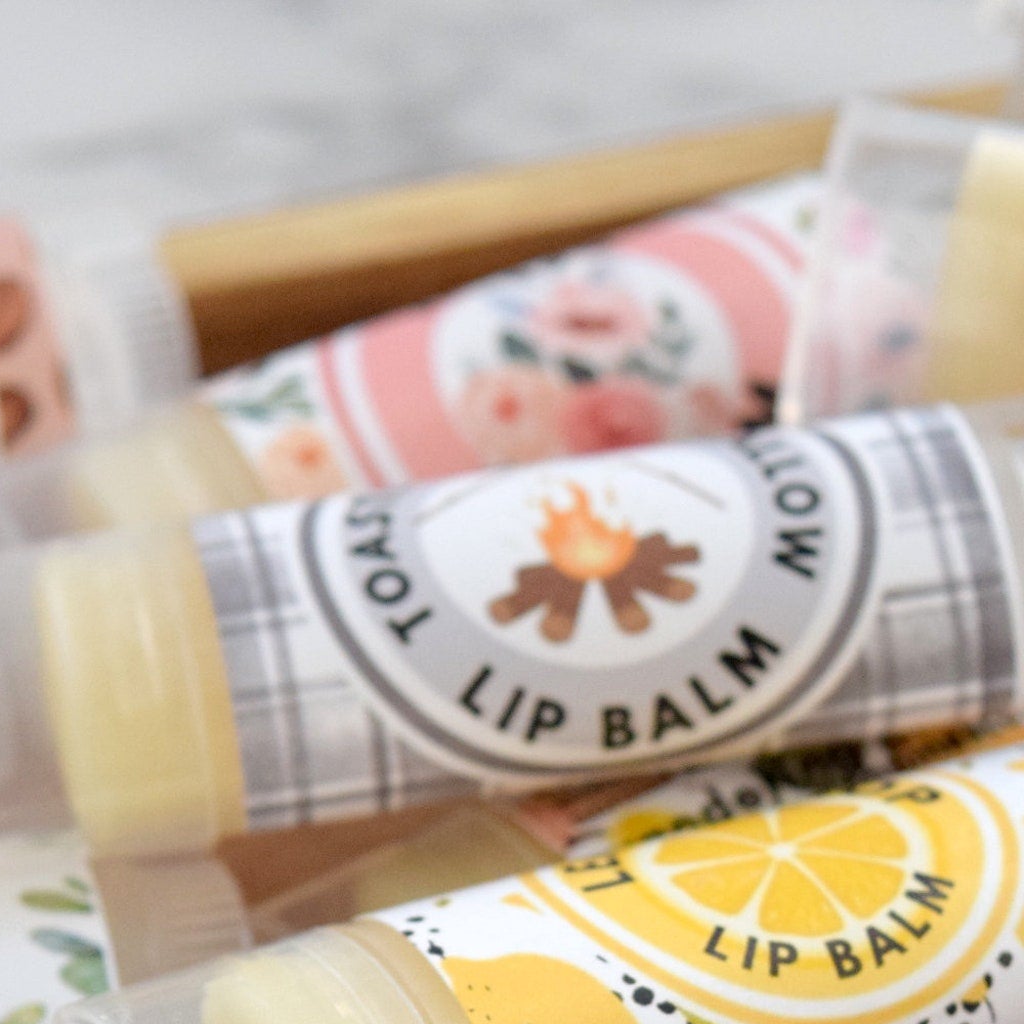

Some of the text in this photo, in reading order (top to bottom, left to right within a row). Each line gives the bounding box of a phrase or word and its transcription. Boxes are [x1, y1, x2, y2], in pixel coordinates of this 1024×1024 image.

[346, 496, 432, 645] TOAS
[458, 624, 782, 750] LIP BALM
[703, 870, 955, 980] LIP BALM
